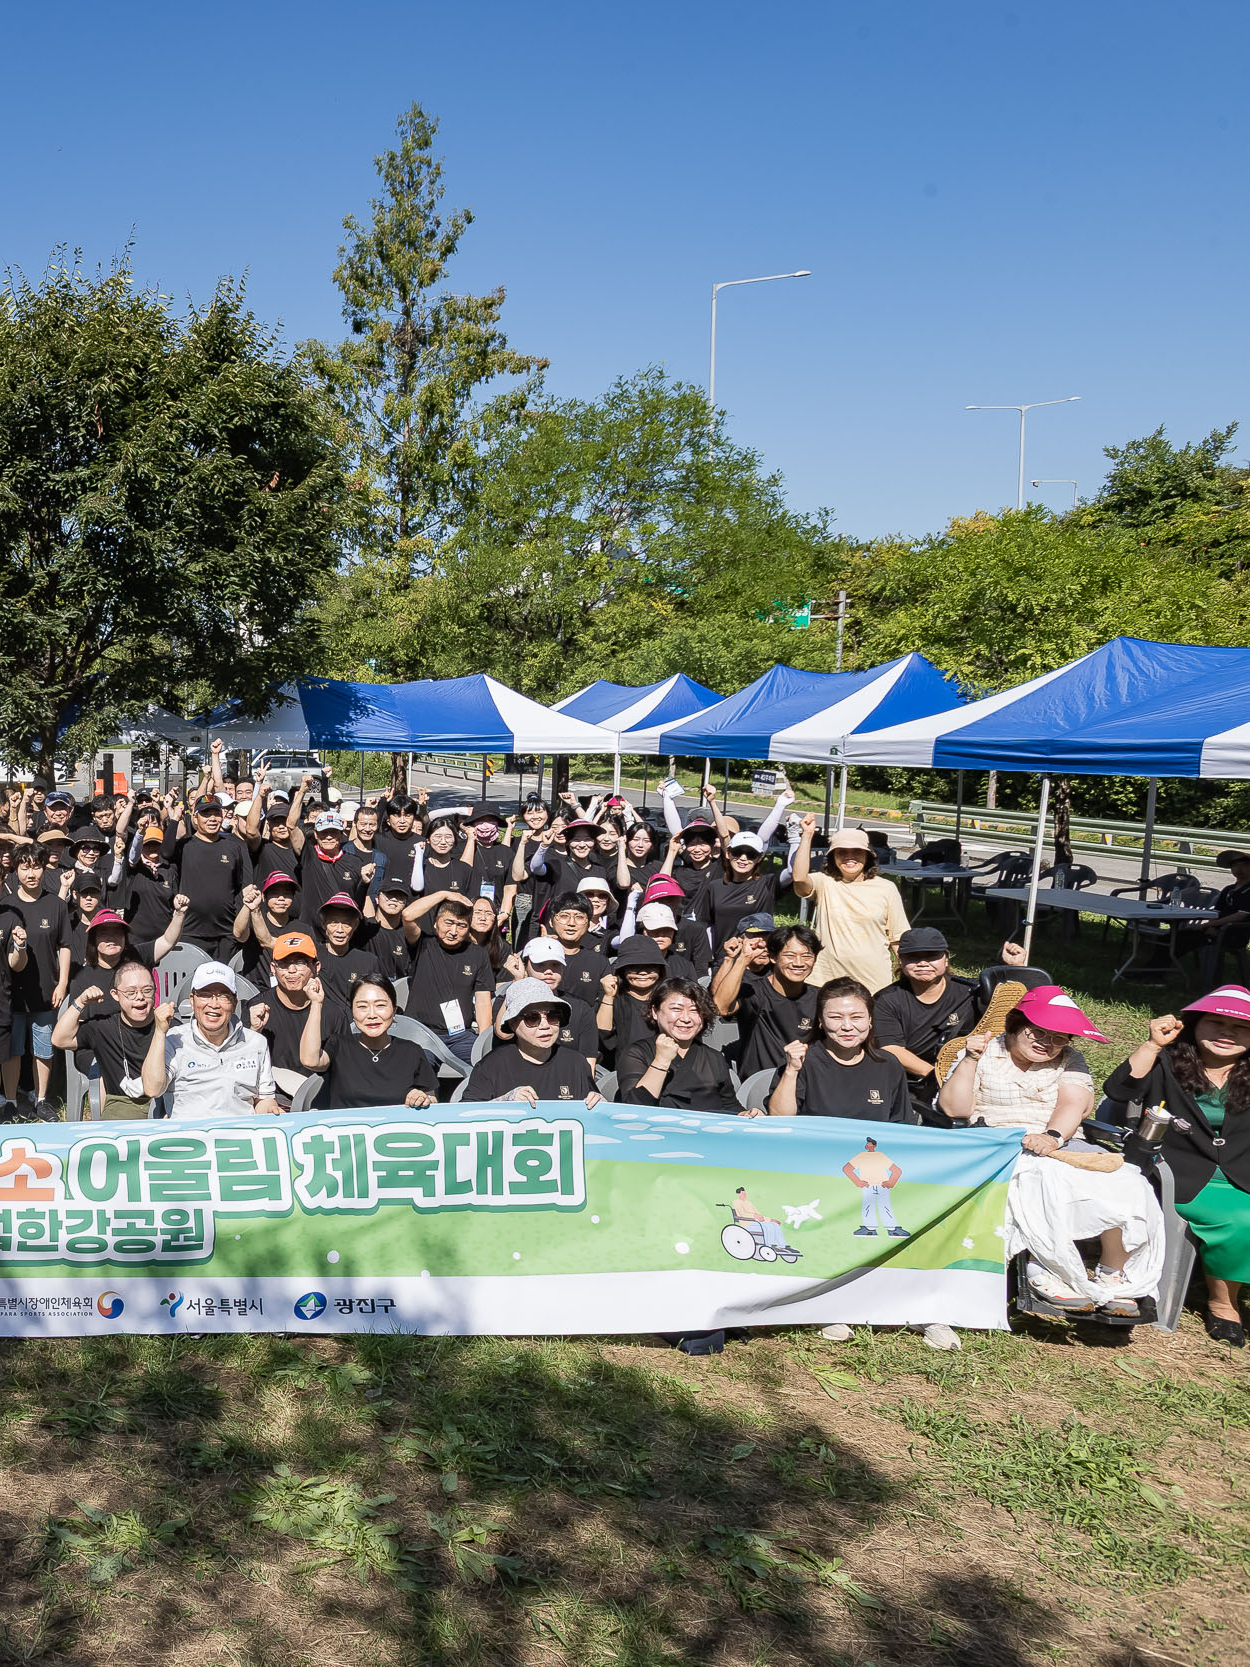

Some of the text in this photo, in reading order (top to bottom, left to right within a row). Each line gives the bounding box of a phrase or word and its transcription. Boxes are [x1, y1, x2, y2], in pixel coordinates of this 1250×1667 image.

[78, 1136, 282, 1203] 어울림
[302, 1128, 574, 1199] 체육대회
[186, 1297, 264, 1316] 서울특별시
[333, 1297, 397, 1315] 광진구
